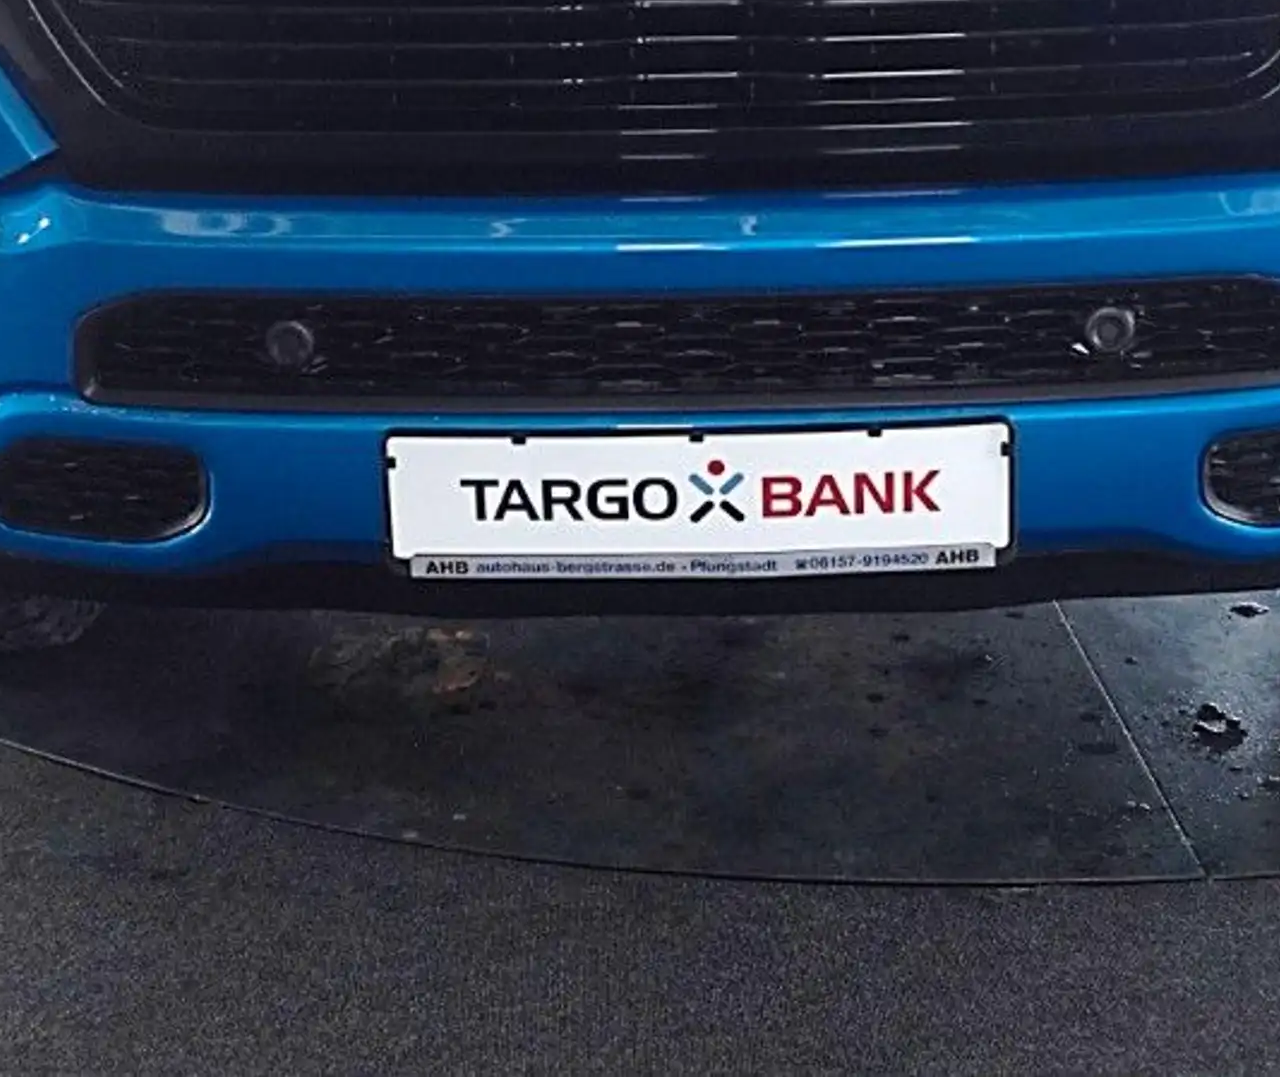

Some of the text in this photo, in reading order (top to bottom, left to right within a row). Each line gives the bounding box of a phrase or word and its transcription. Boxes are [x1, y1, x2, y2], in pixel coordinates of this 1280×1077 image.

[460, 468, 942, 522] TARGO BANK
[425, 559, 470, 575] AHB
[689, 557, 778, 574] Pfungstadt
[934, 548, 981, 565] AHB
